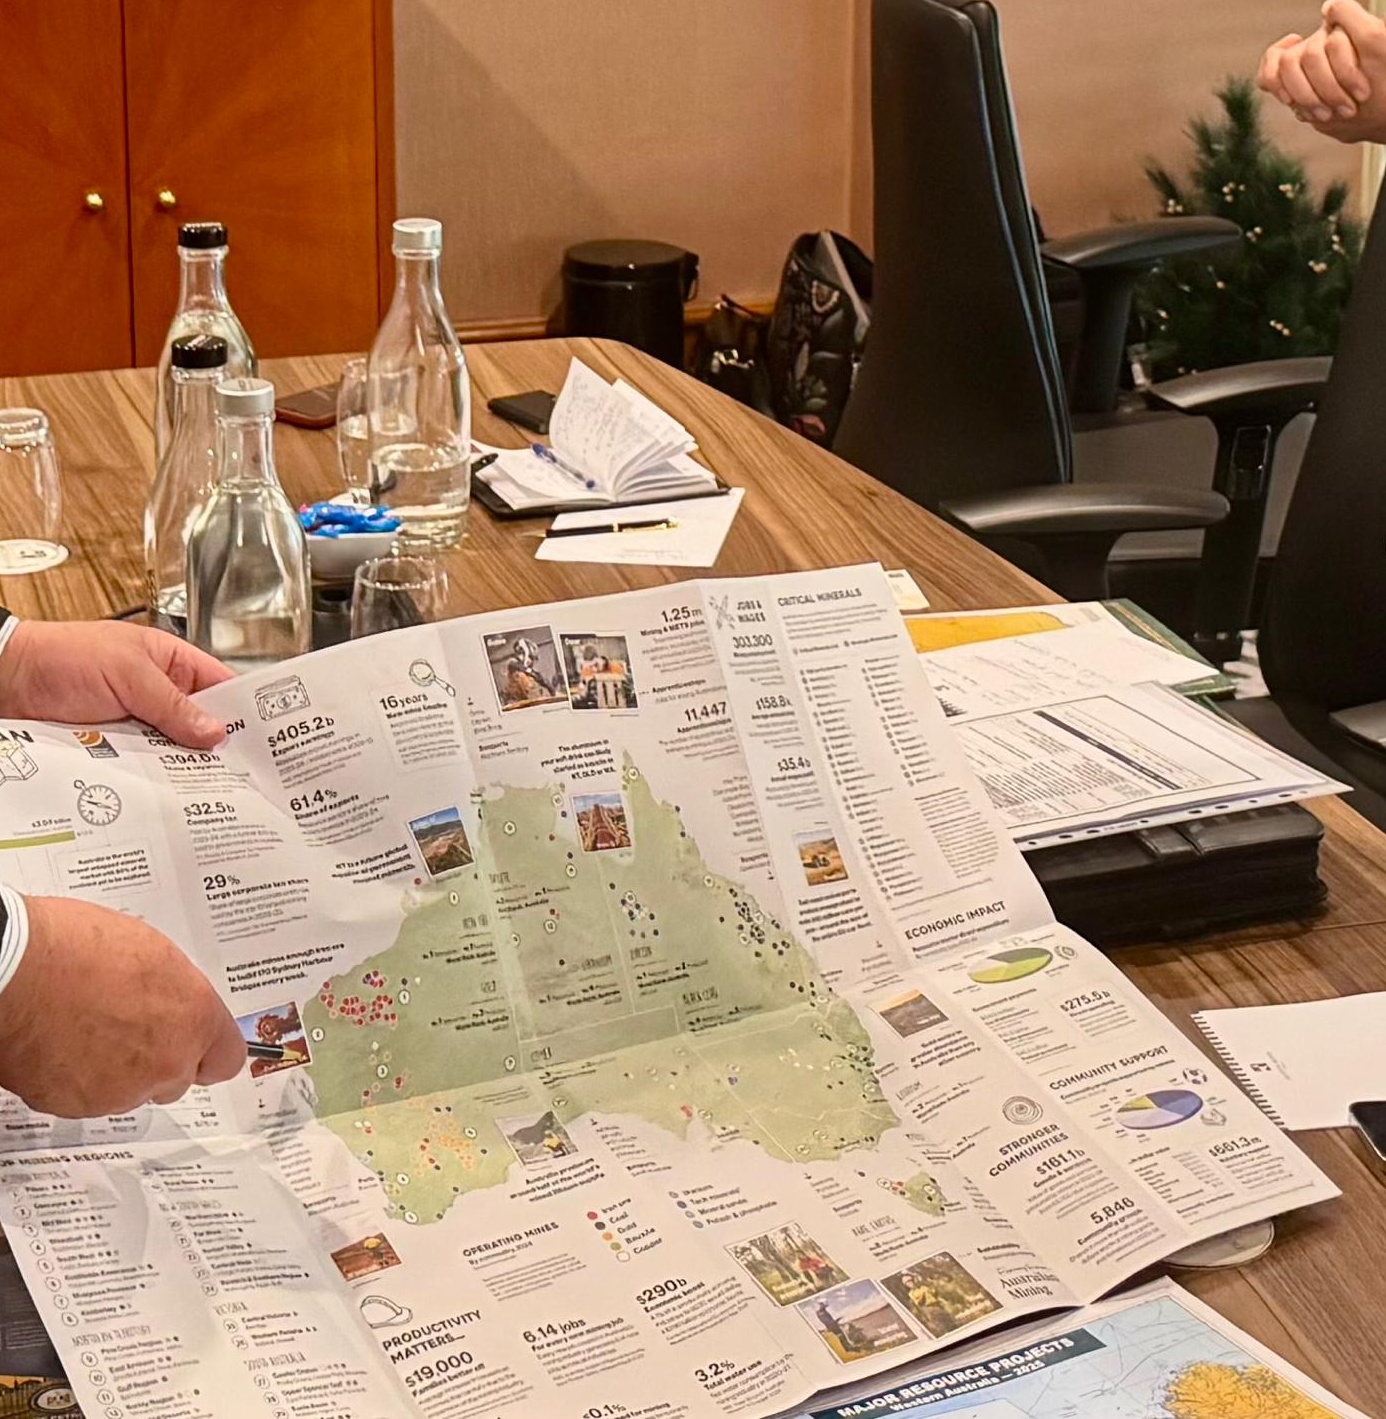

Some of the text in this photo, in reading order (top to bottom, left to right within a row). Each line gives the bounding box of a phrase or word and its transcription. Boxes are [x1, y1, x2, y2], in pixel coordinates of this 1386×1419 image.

[777, 588, 862, 607] CRITICAL MINERALS
[379, 695, 399, 711] 16
[268, 716, 335, 748] $405.2b
[183, 802, 235, 817] $32.5b
[290, 789, 338, 812] 61.4%
[203, 874, 241, 891] 29%
[905, 901, 1006, 940] ECONOMIC IMPACT
[272, 963, 301, 975] Sydney
[302, 956, 333, 967] Harbour
[1049, 1062, 1118, 1090] COMMUNITY
[1119, 1045, 1168, 1066] SUPPORT
[999, 1124, 1060, 1156] STRONGER
[74, 1151, 134, 1161] REGIONS
[989, 1133, 1069, 1177] COMMUNITIES
[609, 1212, 629, 1224] Coal
[698, 1204, 725, 1216] Mineral
[463, 1221, 560, 1257] OPERATING MINES
[617, 1222, 637, 1234] Gold
[625, 1227, 656, 1245] Bauxite
[633, 1238, 663, 1254] Copper
[636, 1279, 688, 1305] $290b
[382, 1309, 483, 1352] PRODUCTIVITY
[523, 1318, 587, 1344] 6.14 jobs
[542, 1338, 562, 1350] every
[405, 1351, 474, 1388] $19,000
[447, 1368, 471, 1384] better
[694, 1360, 736, 1383] 3.2%
[704, 1376, 723, 1392] Total
[723, 1368, 747, 1383] water
[837, 1337, 1075, 1418] MAJOR RESOURCE PROJECTS
[889, 1393, 944, 1412] Western
[946, 1377, 1001, 1397] Australia
